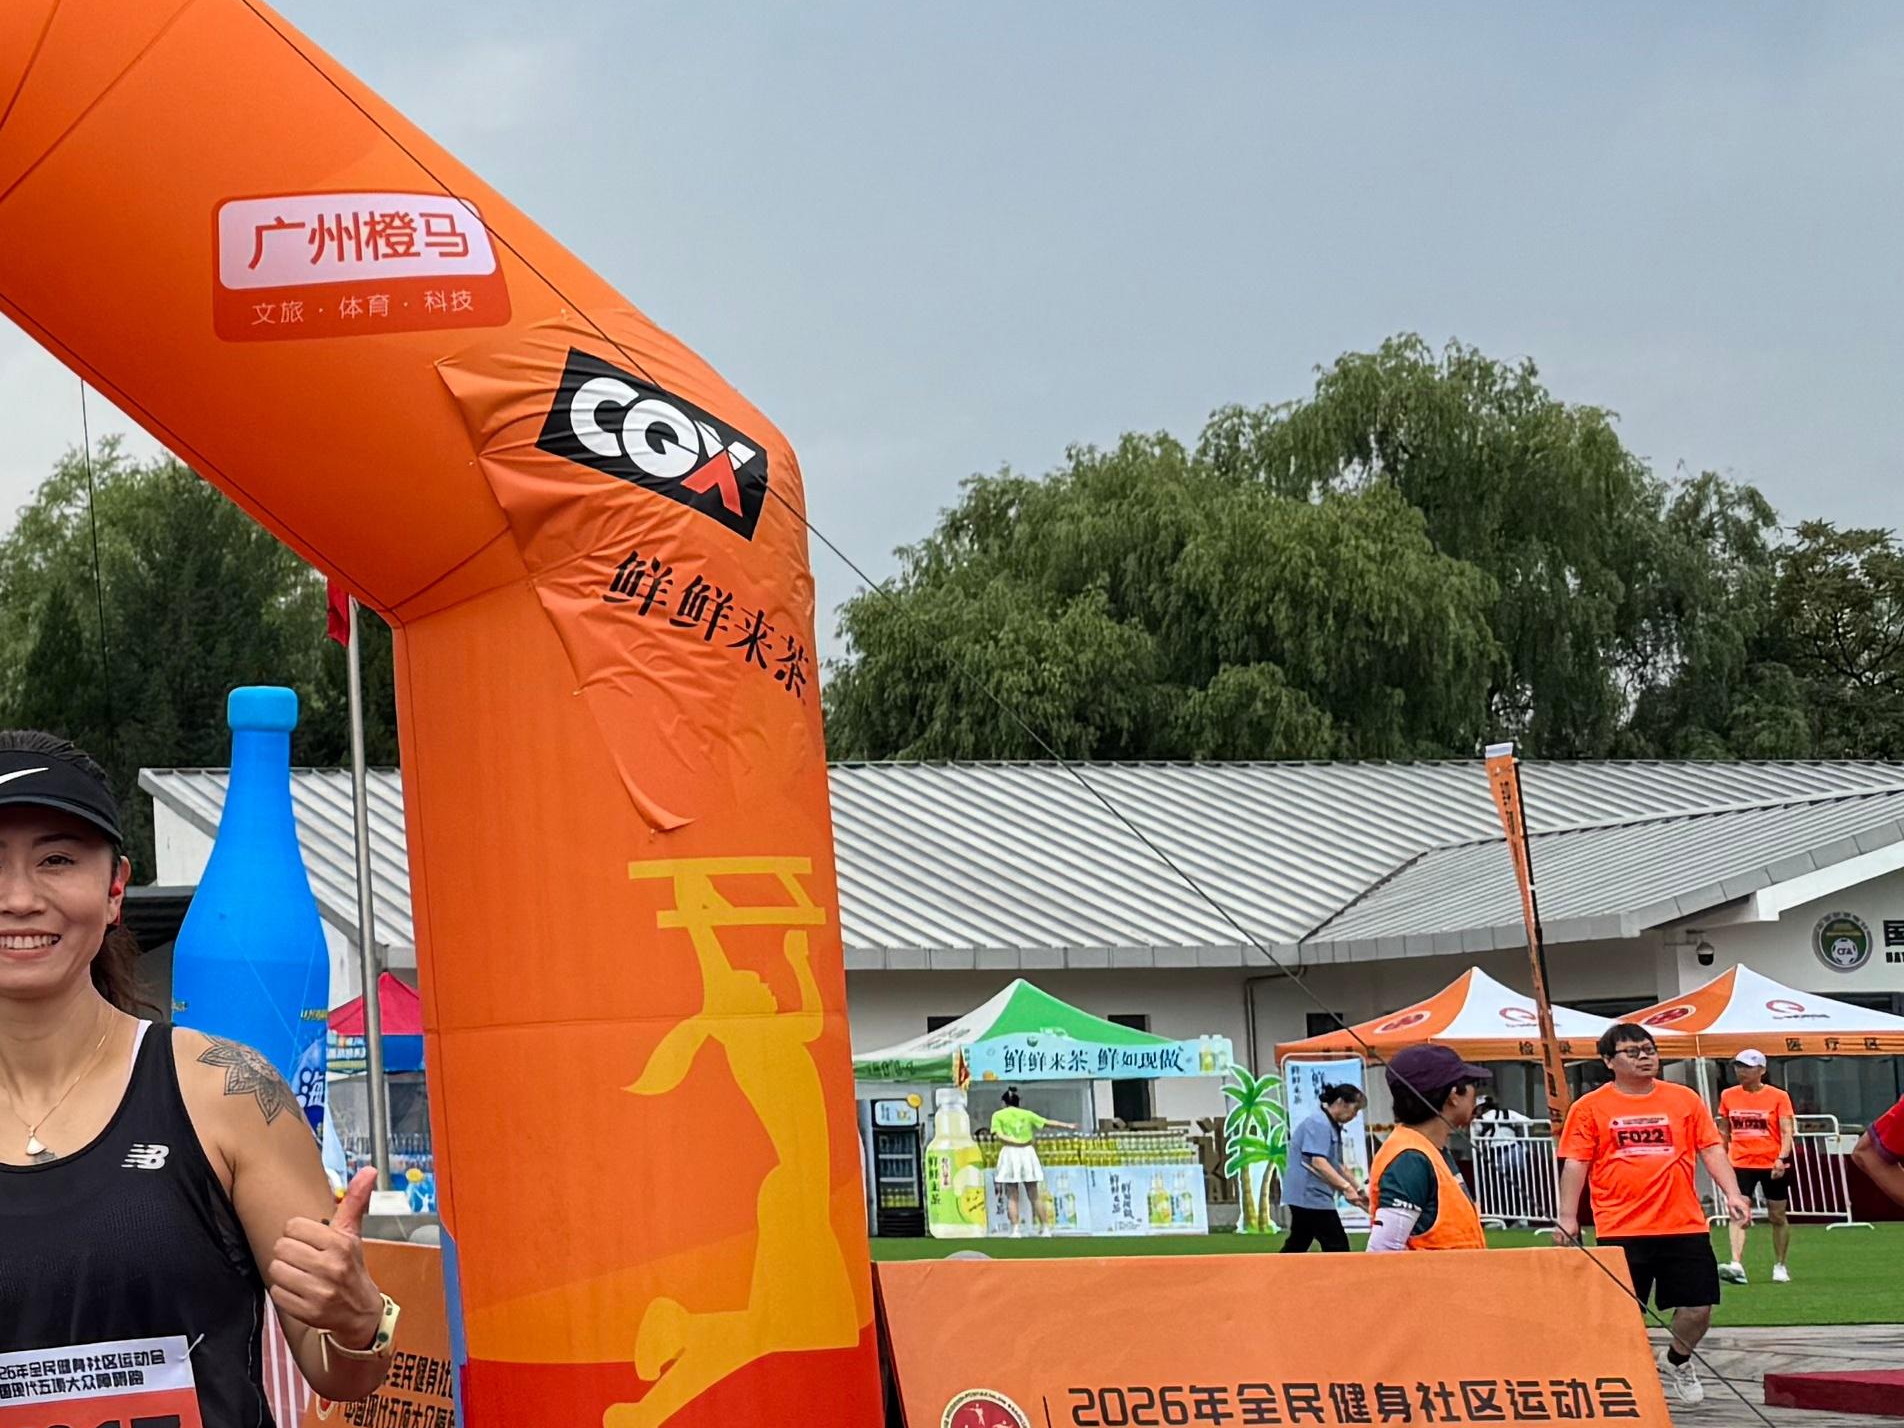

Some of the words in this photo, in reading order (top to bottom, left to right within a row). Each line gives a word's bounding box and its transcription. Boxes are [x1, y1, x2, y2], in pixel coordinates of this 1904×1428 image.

[247, 210, 470, 271] 广州橙马
[602, 551, 809, 699] 鲜鲜来茶
[1618, 1128, 1665, 1147] F022
[1068, 1377, 1641, 1428] 2026年全民健身社区运动会
